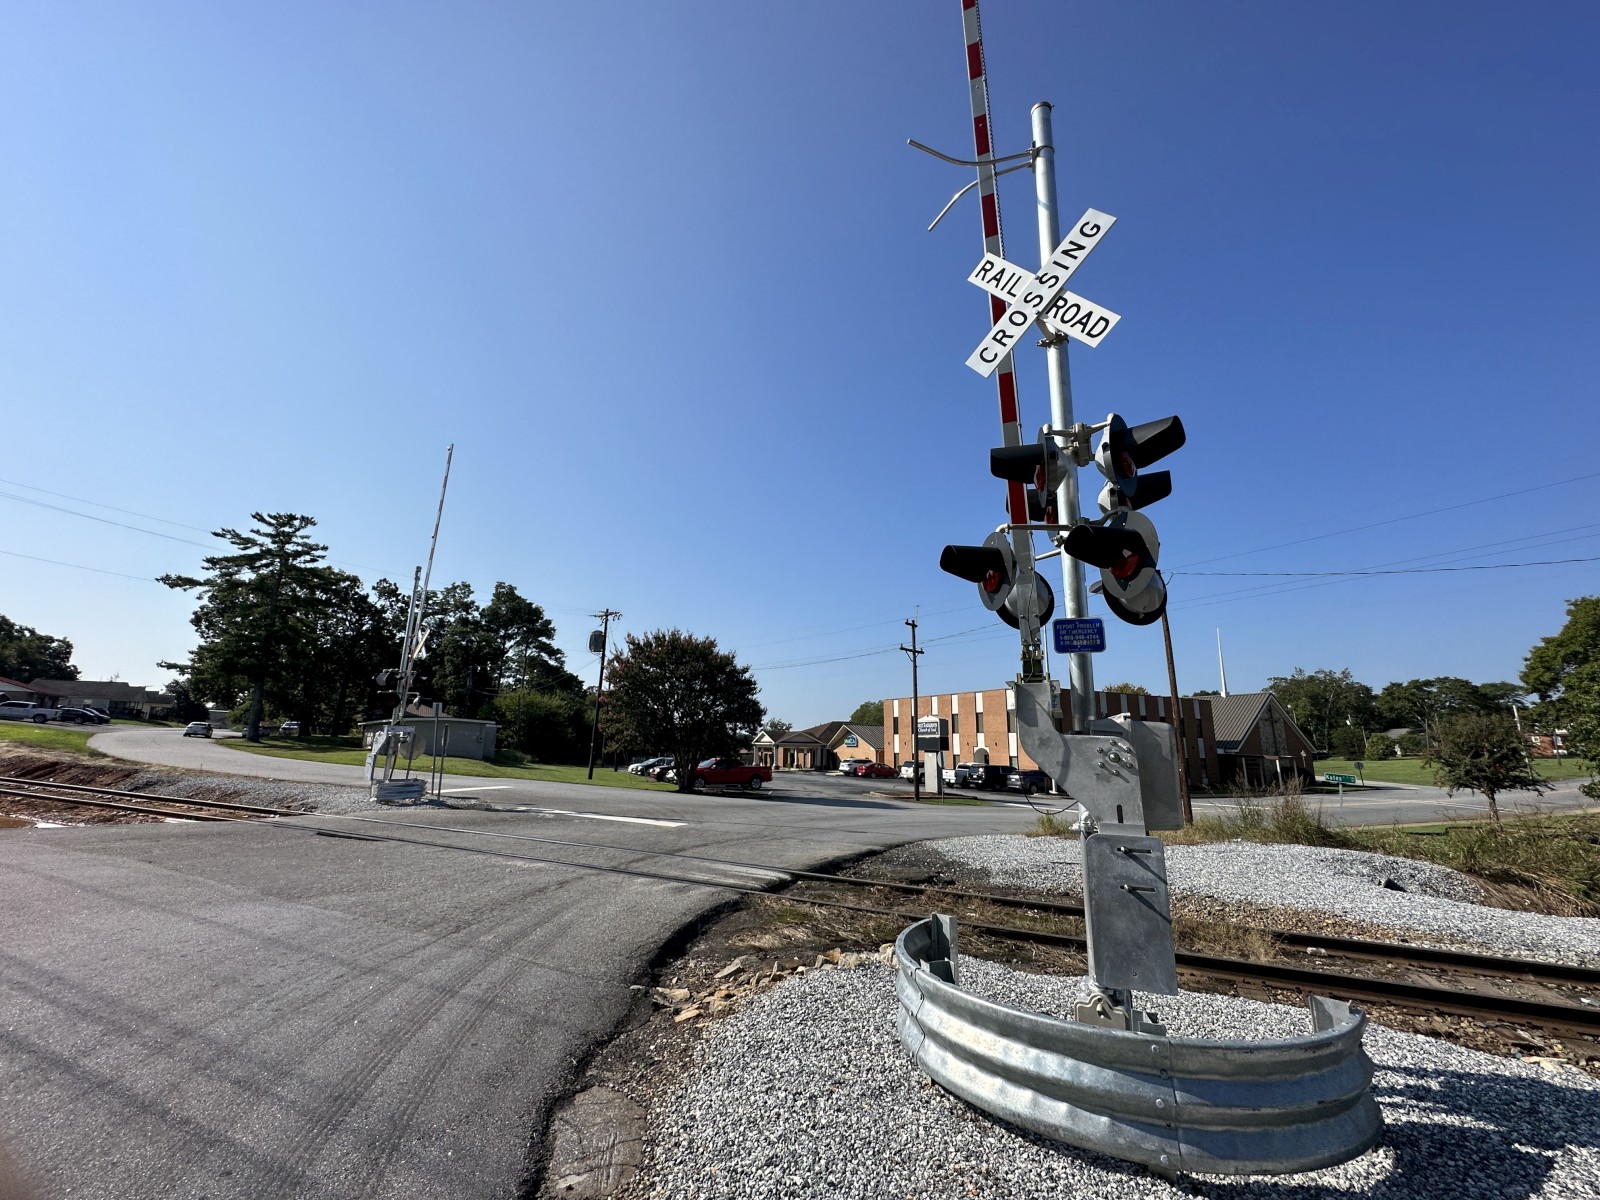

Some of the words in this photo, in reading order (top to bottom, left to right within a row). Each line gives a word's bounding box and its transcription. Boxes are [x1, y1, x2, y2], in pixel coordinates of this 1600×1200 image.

[974, 259, 1022, 298] RAIL
[1045, 295, 1110, 339] ROAD
[979, 221, 1101, 363] CROSSING
